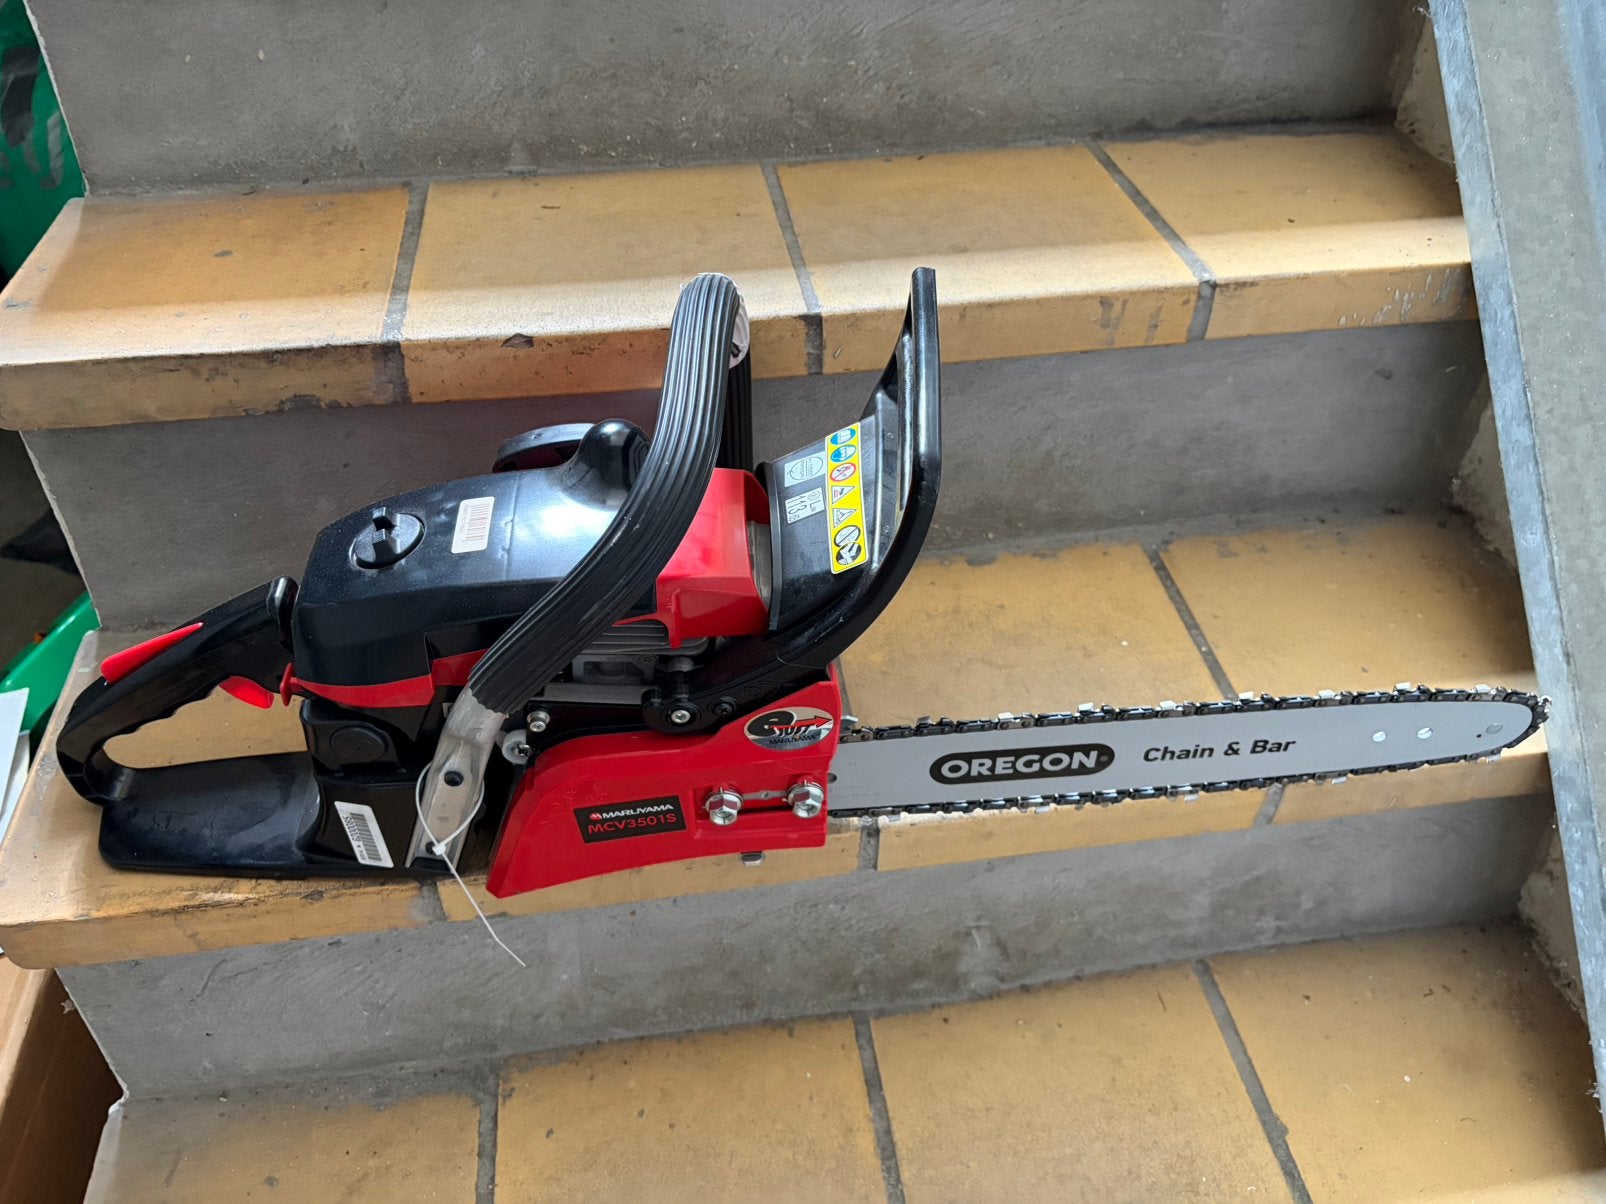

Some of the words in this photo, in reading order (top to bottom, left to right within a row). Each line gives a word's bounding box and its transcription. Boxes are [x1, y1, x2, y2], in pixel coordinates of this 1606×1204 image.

[1143, 744, 1215, 762] Chain
[1223, 741, 1241, 756] &
[1250, 739, 1297, 754] Bar
[940, 750, 1099, 779] OREGON
[602, 804, 675, 819] MARUYAMA
[588, 813, 677, 834] MCV3501S
